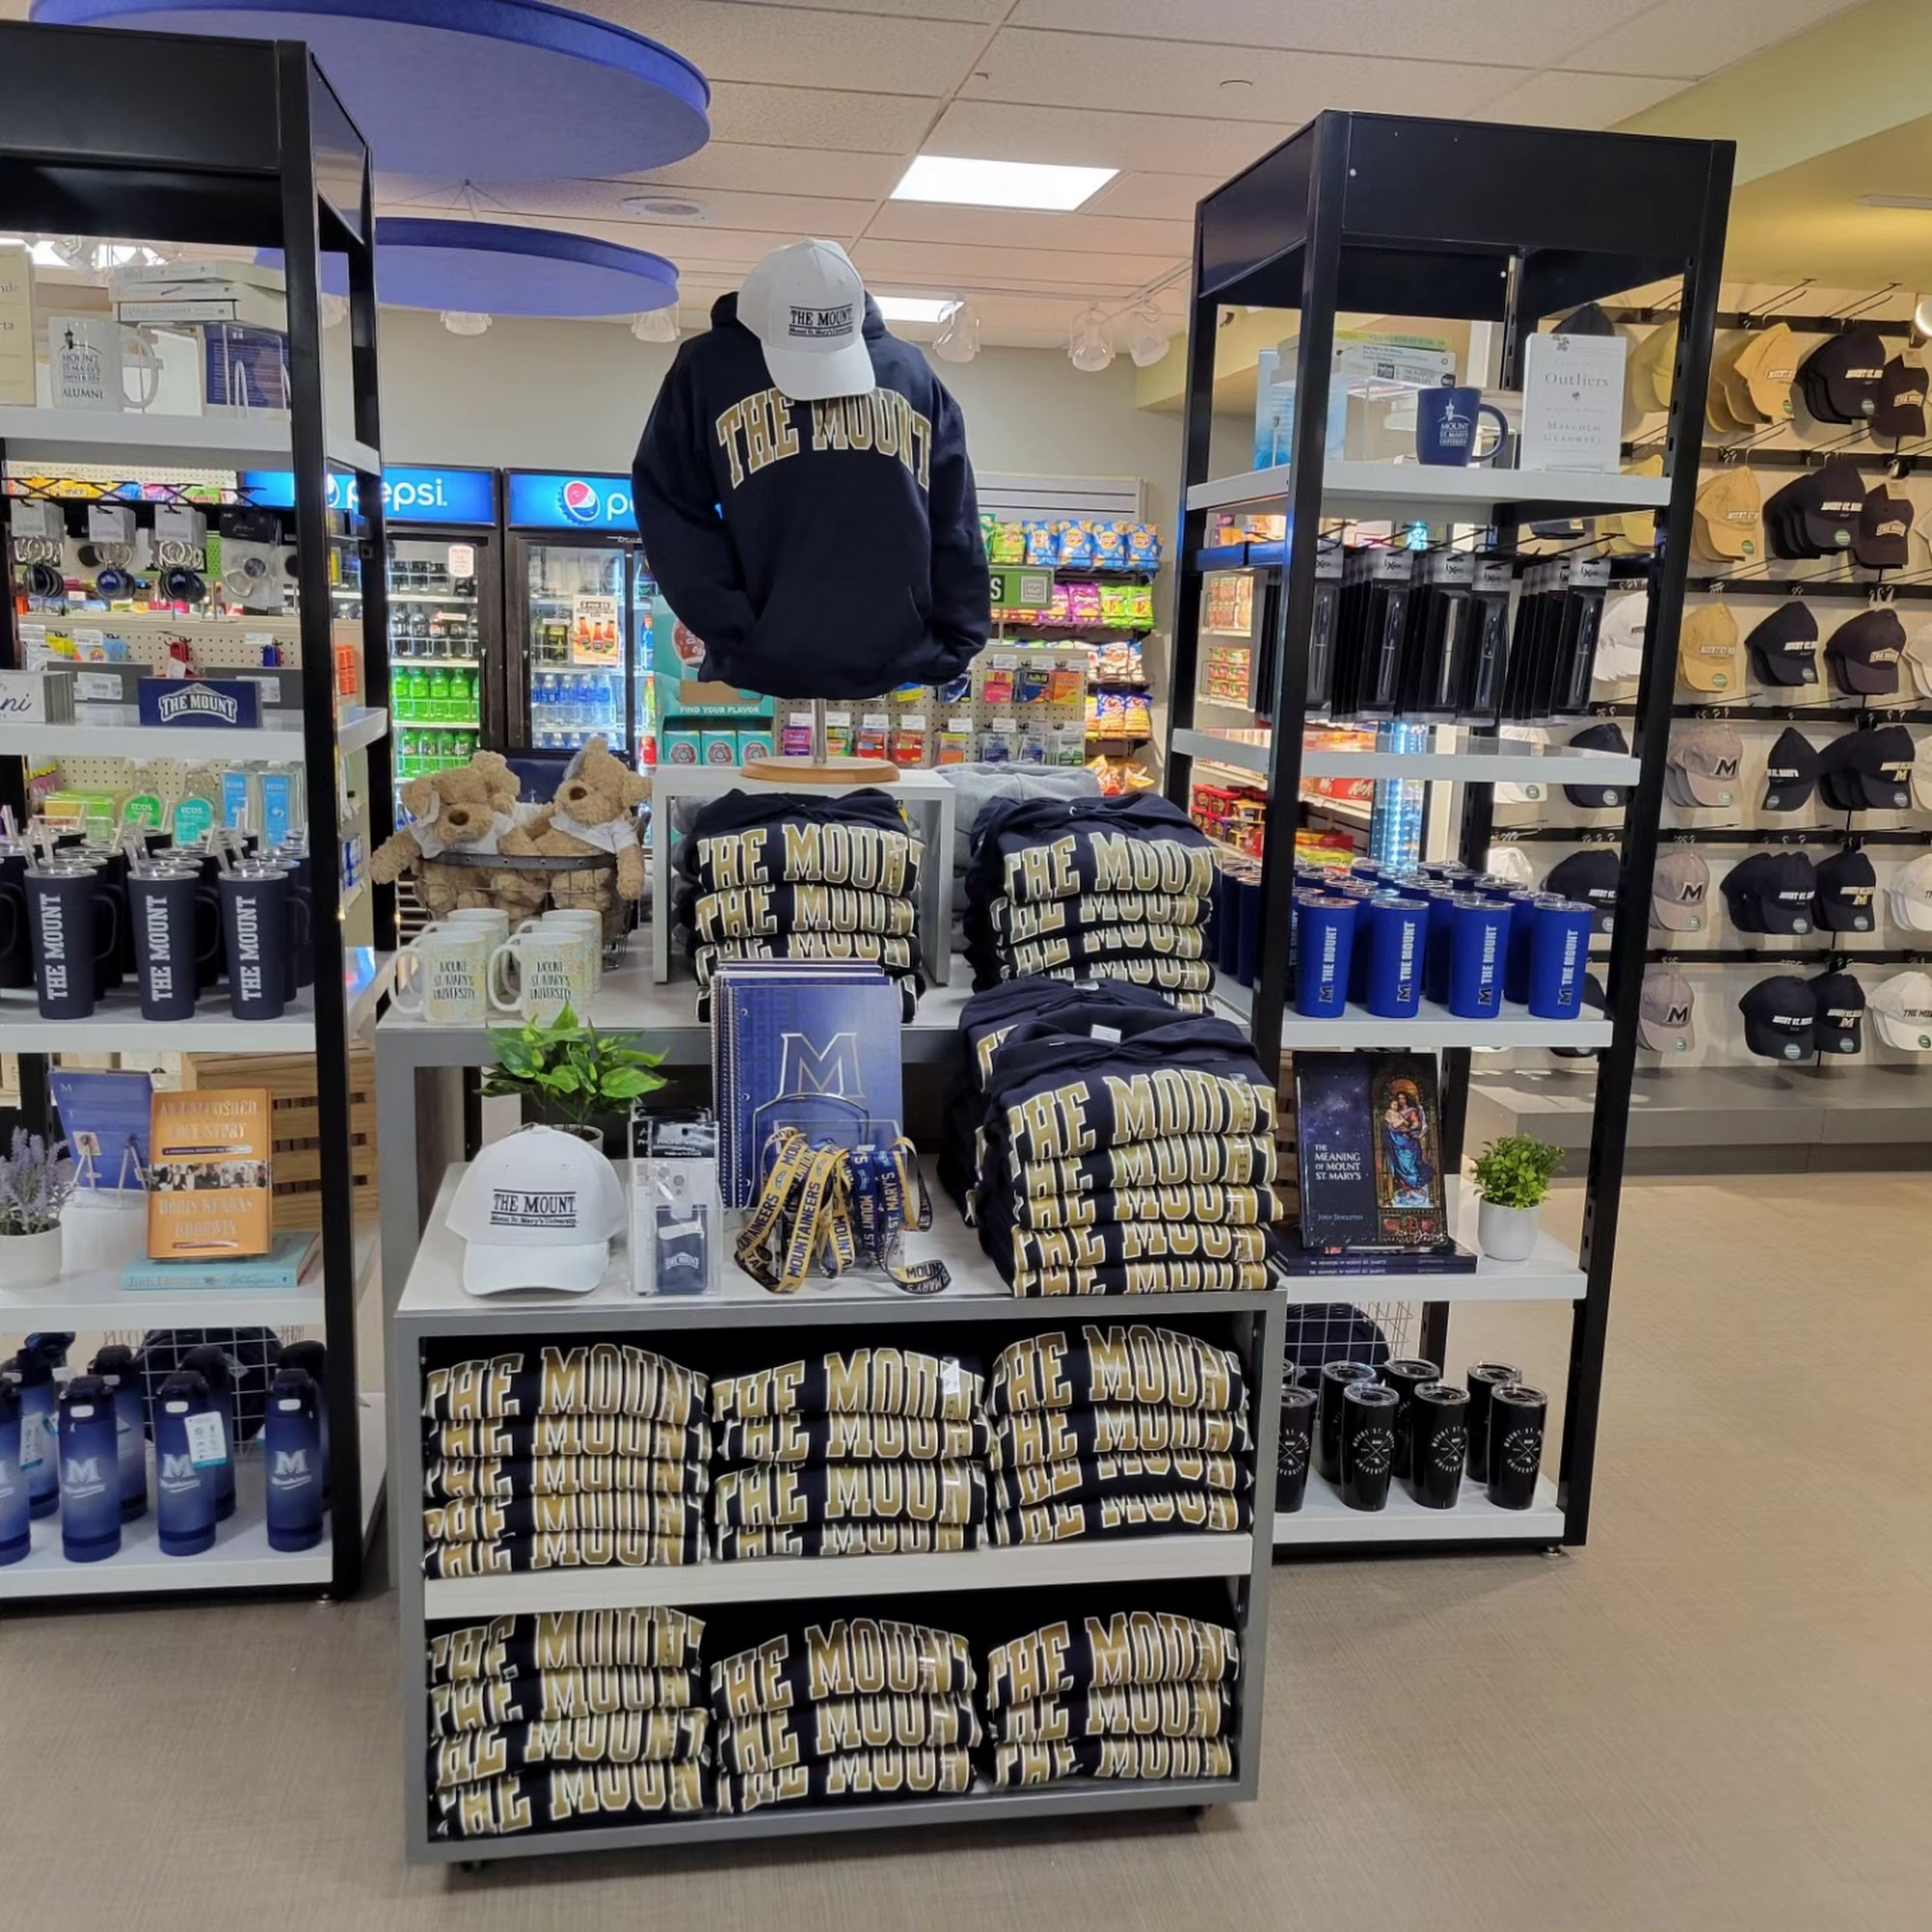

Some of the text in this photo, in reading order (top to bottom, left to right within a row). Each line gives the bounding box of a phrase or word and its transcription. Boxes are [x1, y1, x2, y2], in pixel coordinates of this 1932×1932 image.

[791, 307, 852, 327] THE MOUNT
[63, 388, 103, 400] ALUMNI
[1546, 373, 1609, 386] Outliers
[716, 386, 932, 494] THE MOUNT
[161, 693, 238, 723] THE MOUNT
[1712, 756, 1738, 776] M
[697, 827, 769, 890] THE
[1004, 834, 1078, 900] THE
[695, 883, 916, 942] THE MOUN
[1681, 882, 1705, 900] M
[40, 894, 69, 1000] THE MOUNT
[146, 895, 173, 1002] THE MOUNT
[236, 895, 262, 1001] THE MOUNT
[440, 960, 467, 973] MOUNT
[537, 960, 564, 973] MOUNT
[1319, 925, 1338, 1004] M THE MOUNT
[1397, 921, 1416, 1004] M THE MOUNT
[1478, 924, 1497, 1007] M THE MOUNT
[1557, 929, 1579, 1007] M THE MOUNT
[433, 987, 475, 1001] UNIVERSITY
[445, 975, 474, 987] MARY'S
[530, 987, 572, 1001] UNIVERSITY
[542, 975, 571, 987] MARY'S
[1666, 1007, 1688, 1023] M
[781, 1033, 867, 1099] M
[1007, 1068, 1278, 1165] THE MOUNT
[1315, 1151, 1361, 1161] MEANING
[1325, 1162, 1361, 1171] MOUNT
[1329, 1171, 1362, 1180] MARY'S
[494, 1193, 576, 1214] THE MOUNT
[881, 1172, 899, 1212] MARY'S
[787, 1180, 821, 1279] MOUNTAINEERS
[1122, 1220, 1267, 1265] MOUN
[1124, 1261, 1268, 1295] MOUN
[421, 1343, 710, 1426] THE MOUNT
[712, 1347, 984, 1423] THE MOUNT
[984, 1331, 1072, 1416] THE
[66, 1457, 100, 1483] M
[161, 1453, 196, 1478] M
[275, 1449, 310, 1475] M
[715, 1461, 808, 1525] THE
[431, 1605, 707, 1683] THE MOUNT
[987, 1619, 1075, 1716] THE
[710, 1634, 795, 1719] THE
[430, 1665, 691, 1739] THE MOUN
[826, 1747, 970, 1796] MOUN
[1094, 1735, 1233, 1779] MOUN
[549, 1757, 704, 1822] MOUN
